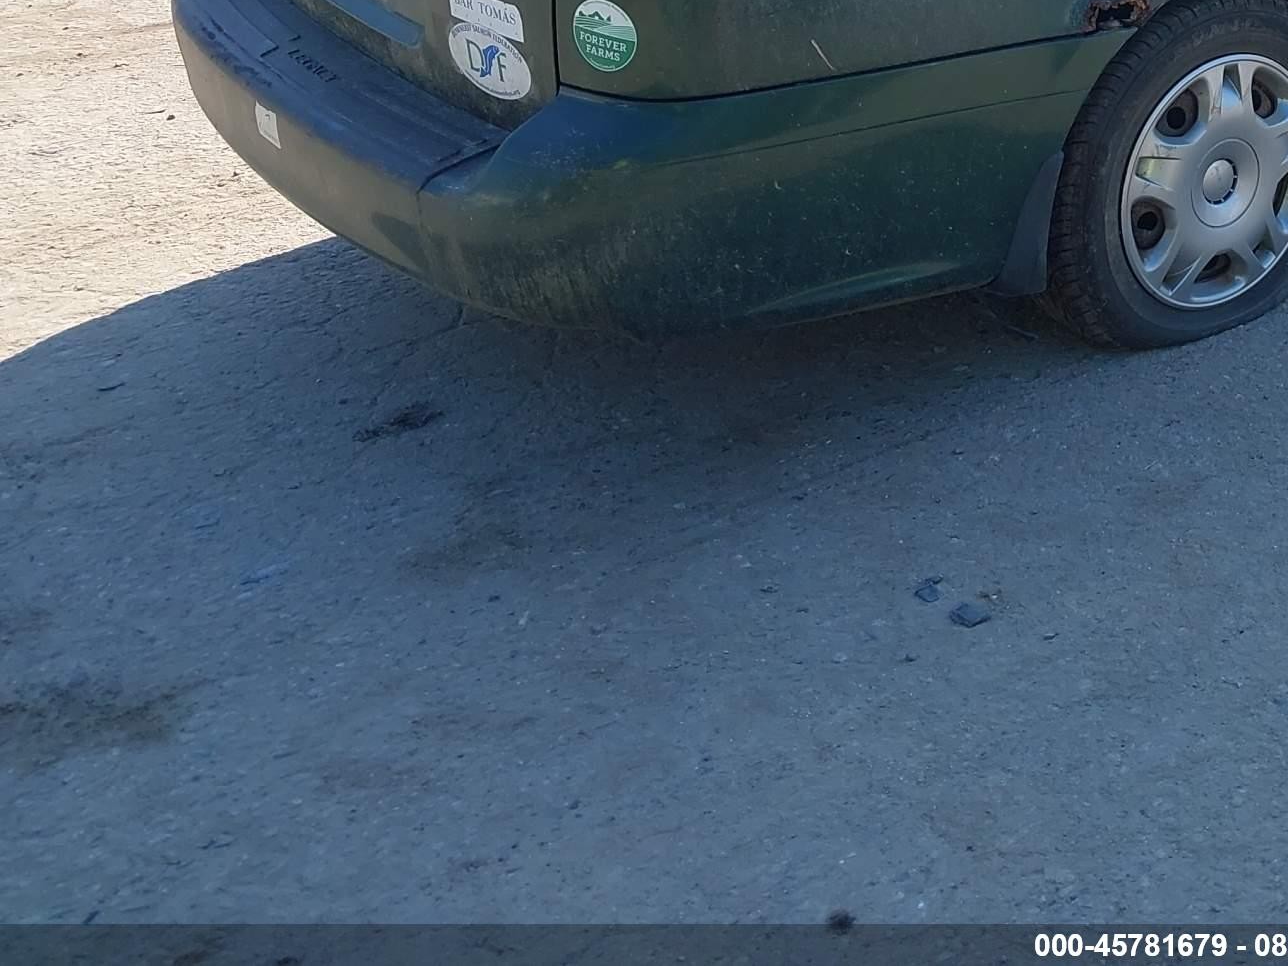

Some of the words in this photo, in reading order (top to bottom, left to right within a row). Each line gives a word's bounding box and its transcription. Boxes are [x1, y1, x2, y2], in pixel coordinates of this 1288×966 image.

[477, 1, 517, 26] TOMÁS
[579, 31, 627, 52] FOREVER
[586, 43, 620, 62] FARMS
